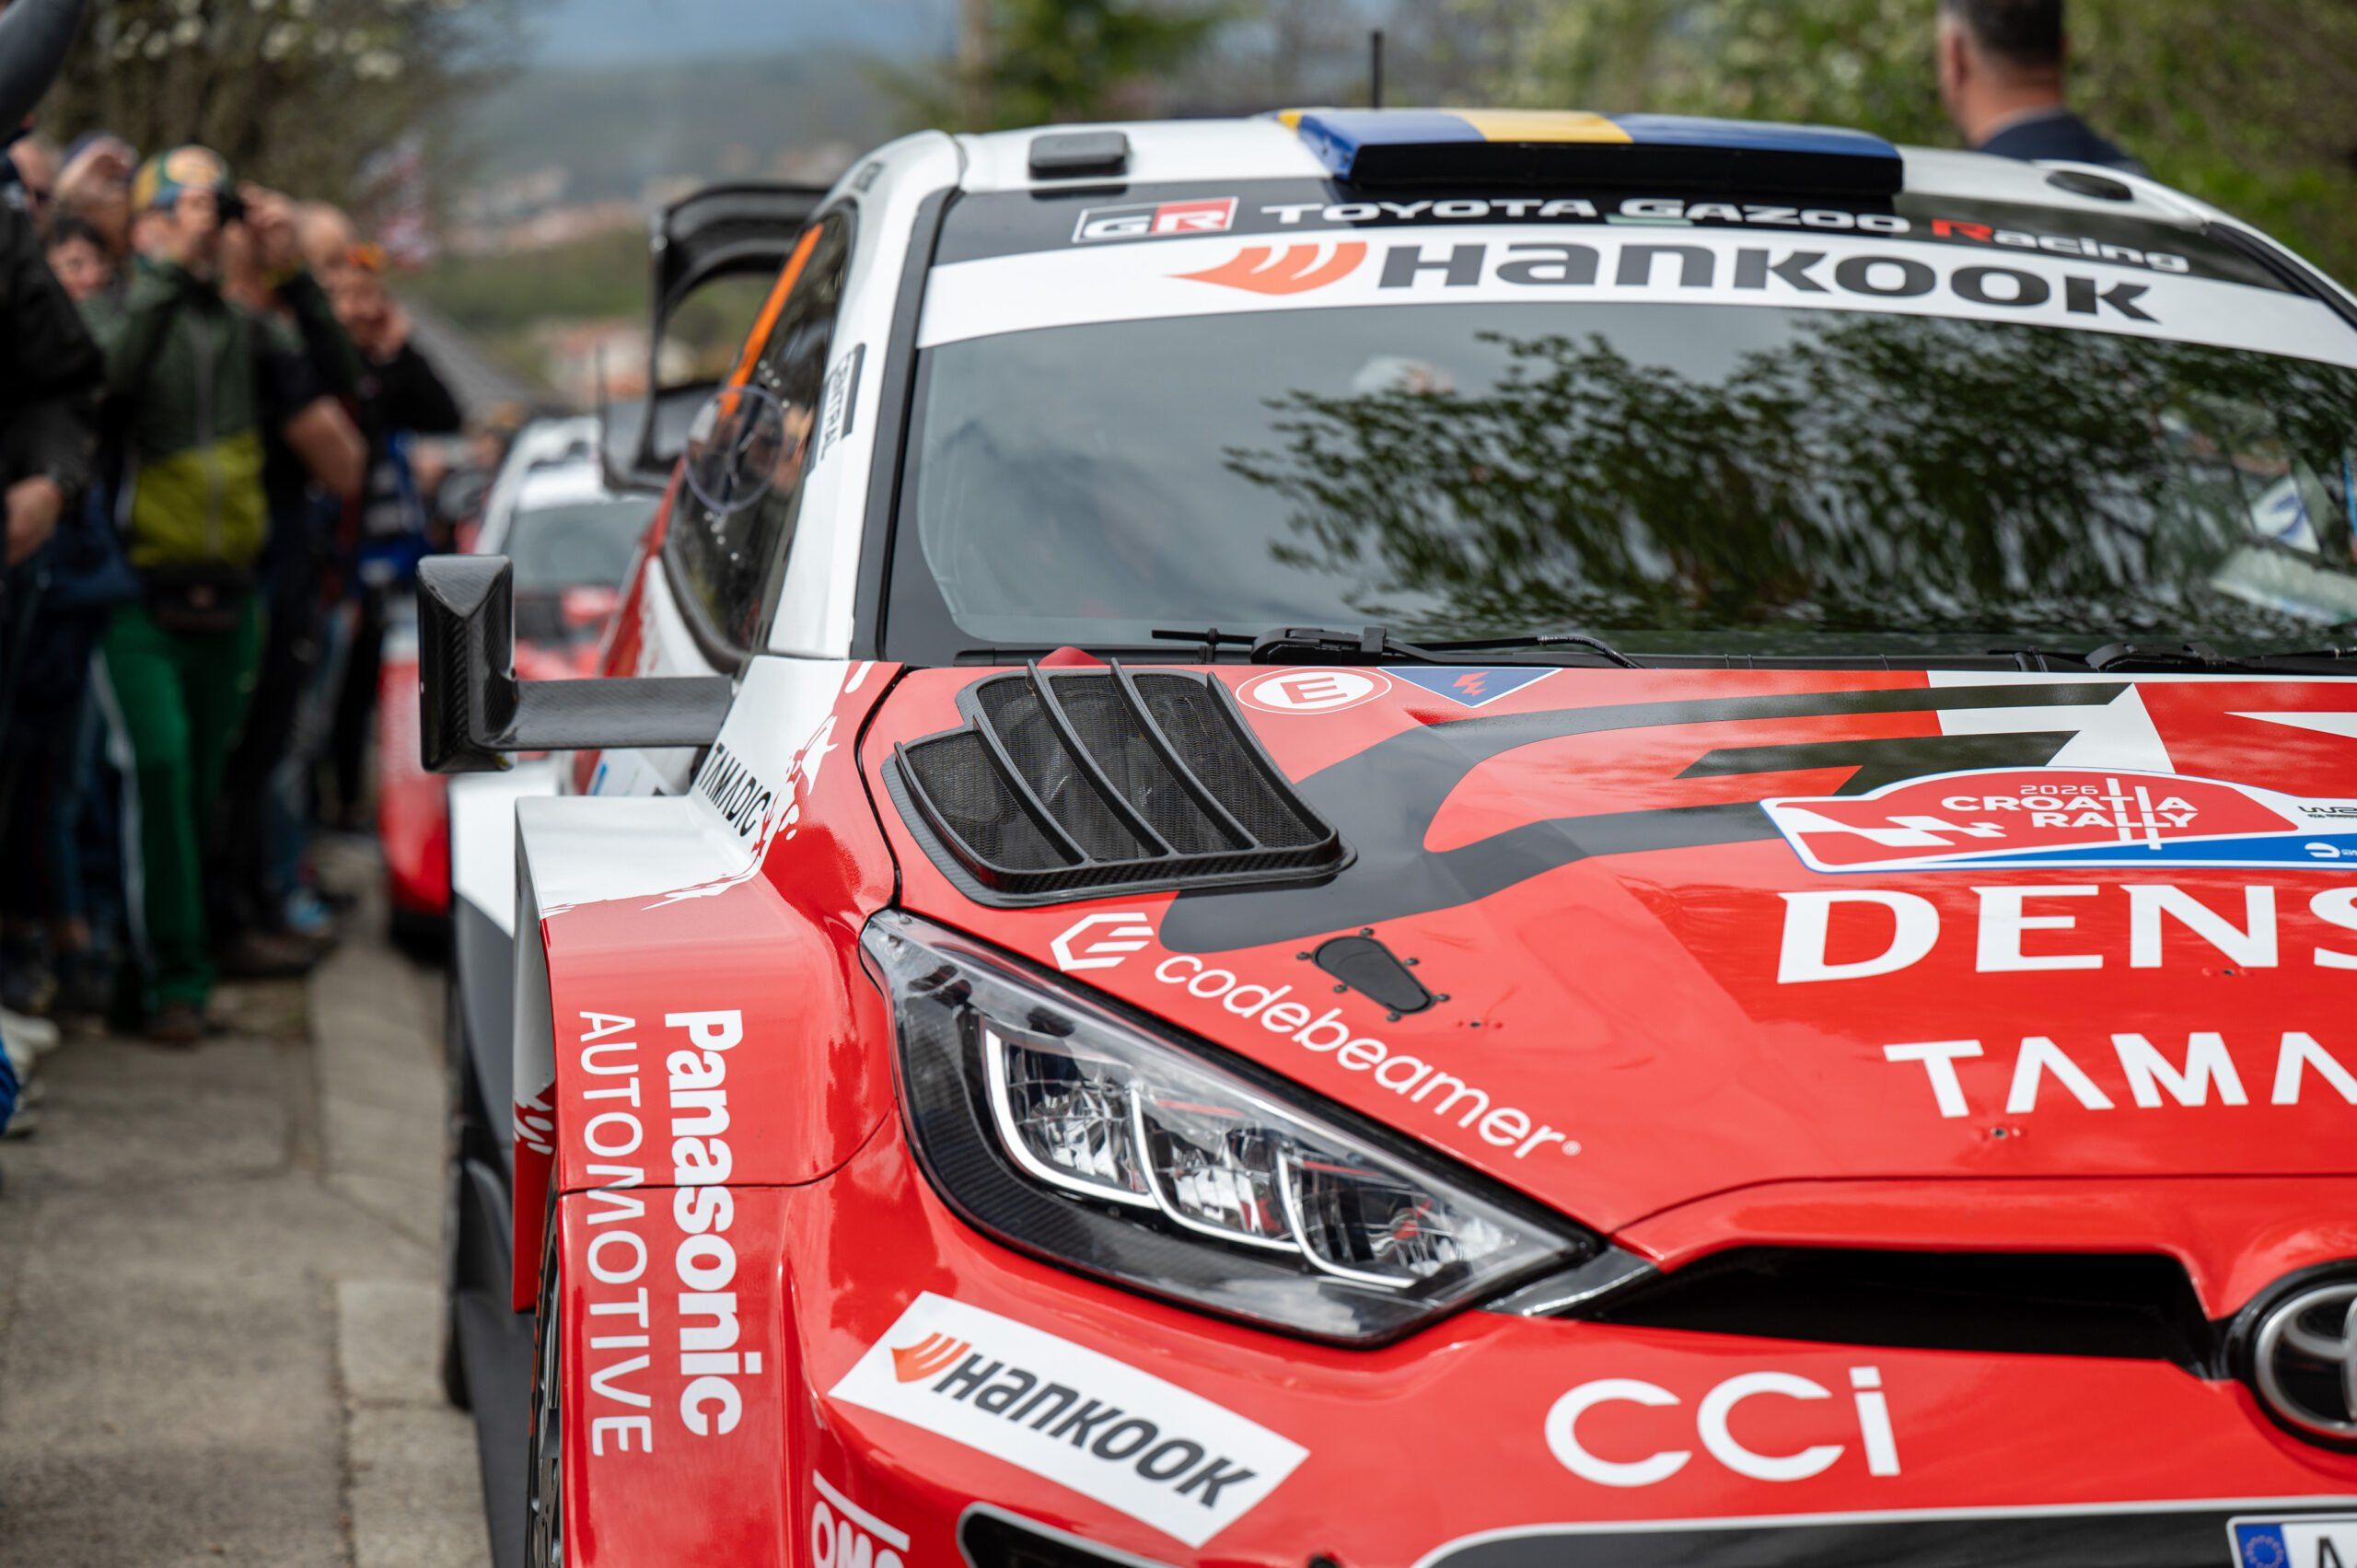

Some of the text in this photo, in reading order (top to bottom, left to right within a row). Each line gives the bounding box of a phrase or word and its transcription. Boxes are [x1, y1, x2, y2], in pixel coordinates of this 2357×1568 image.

[1083, 210, 1226, 238] GR
[1260, 198, 2189, 273] TOYOTA GAZOO Racing
[698, 742, 772, 837] TAMADIC
[2020, 785, 2099, 795] 2026
[579, 1010, 654, 1458] AUTOMOTIVE
[664, 1009, 762, 1437] Panasonic
[811, 1501, 905, 1568] OM
